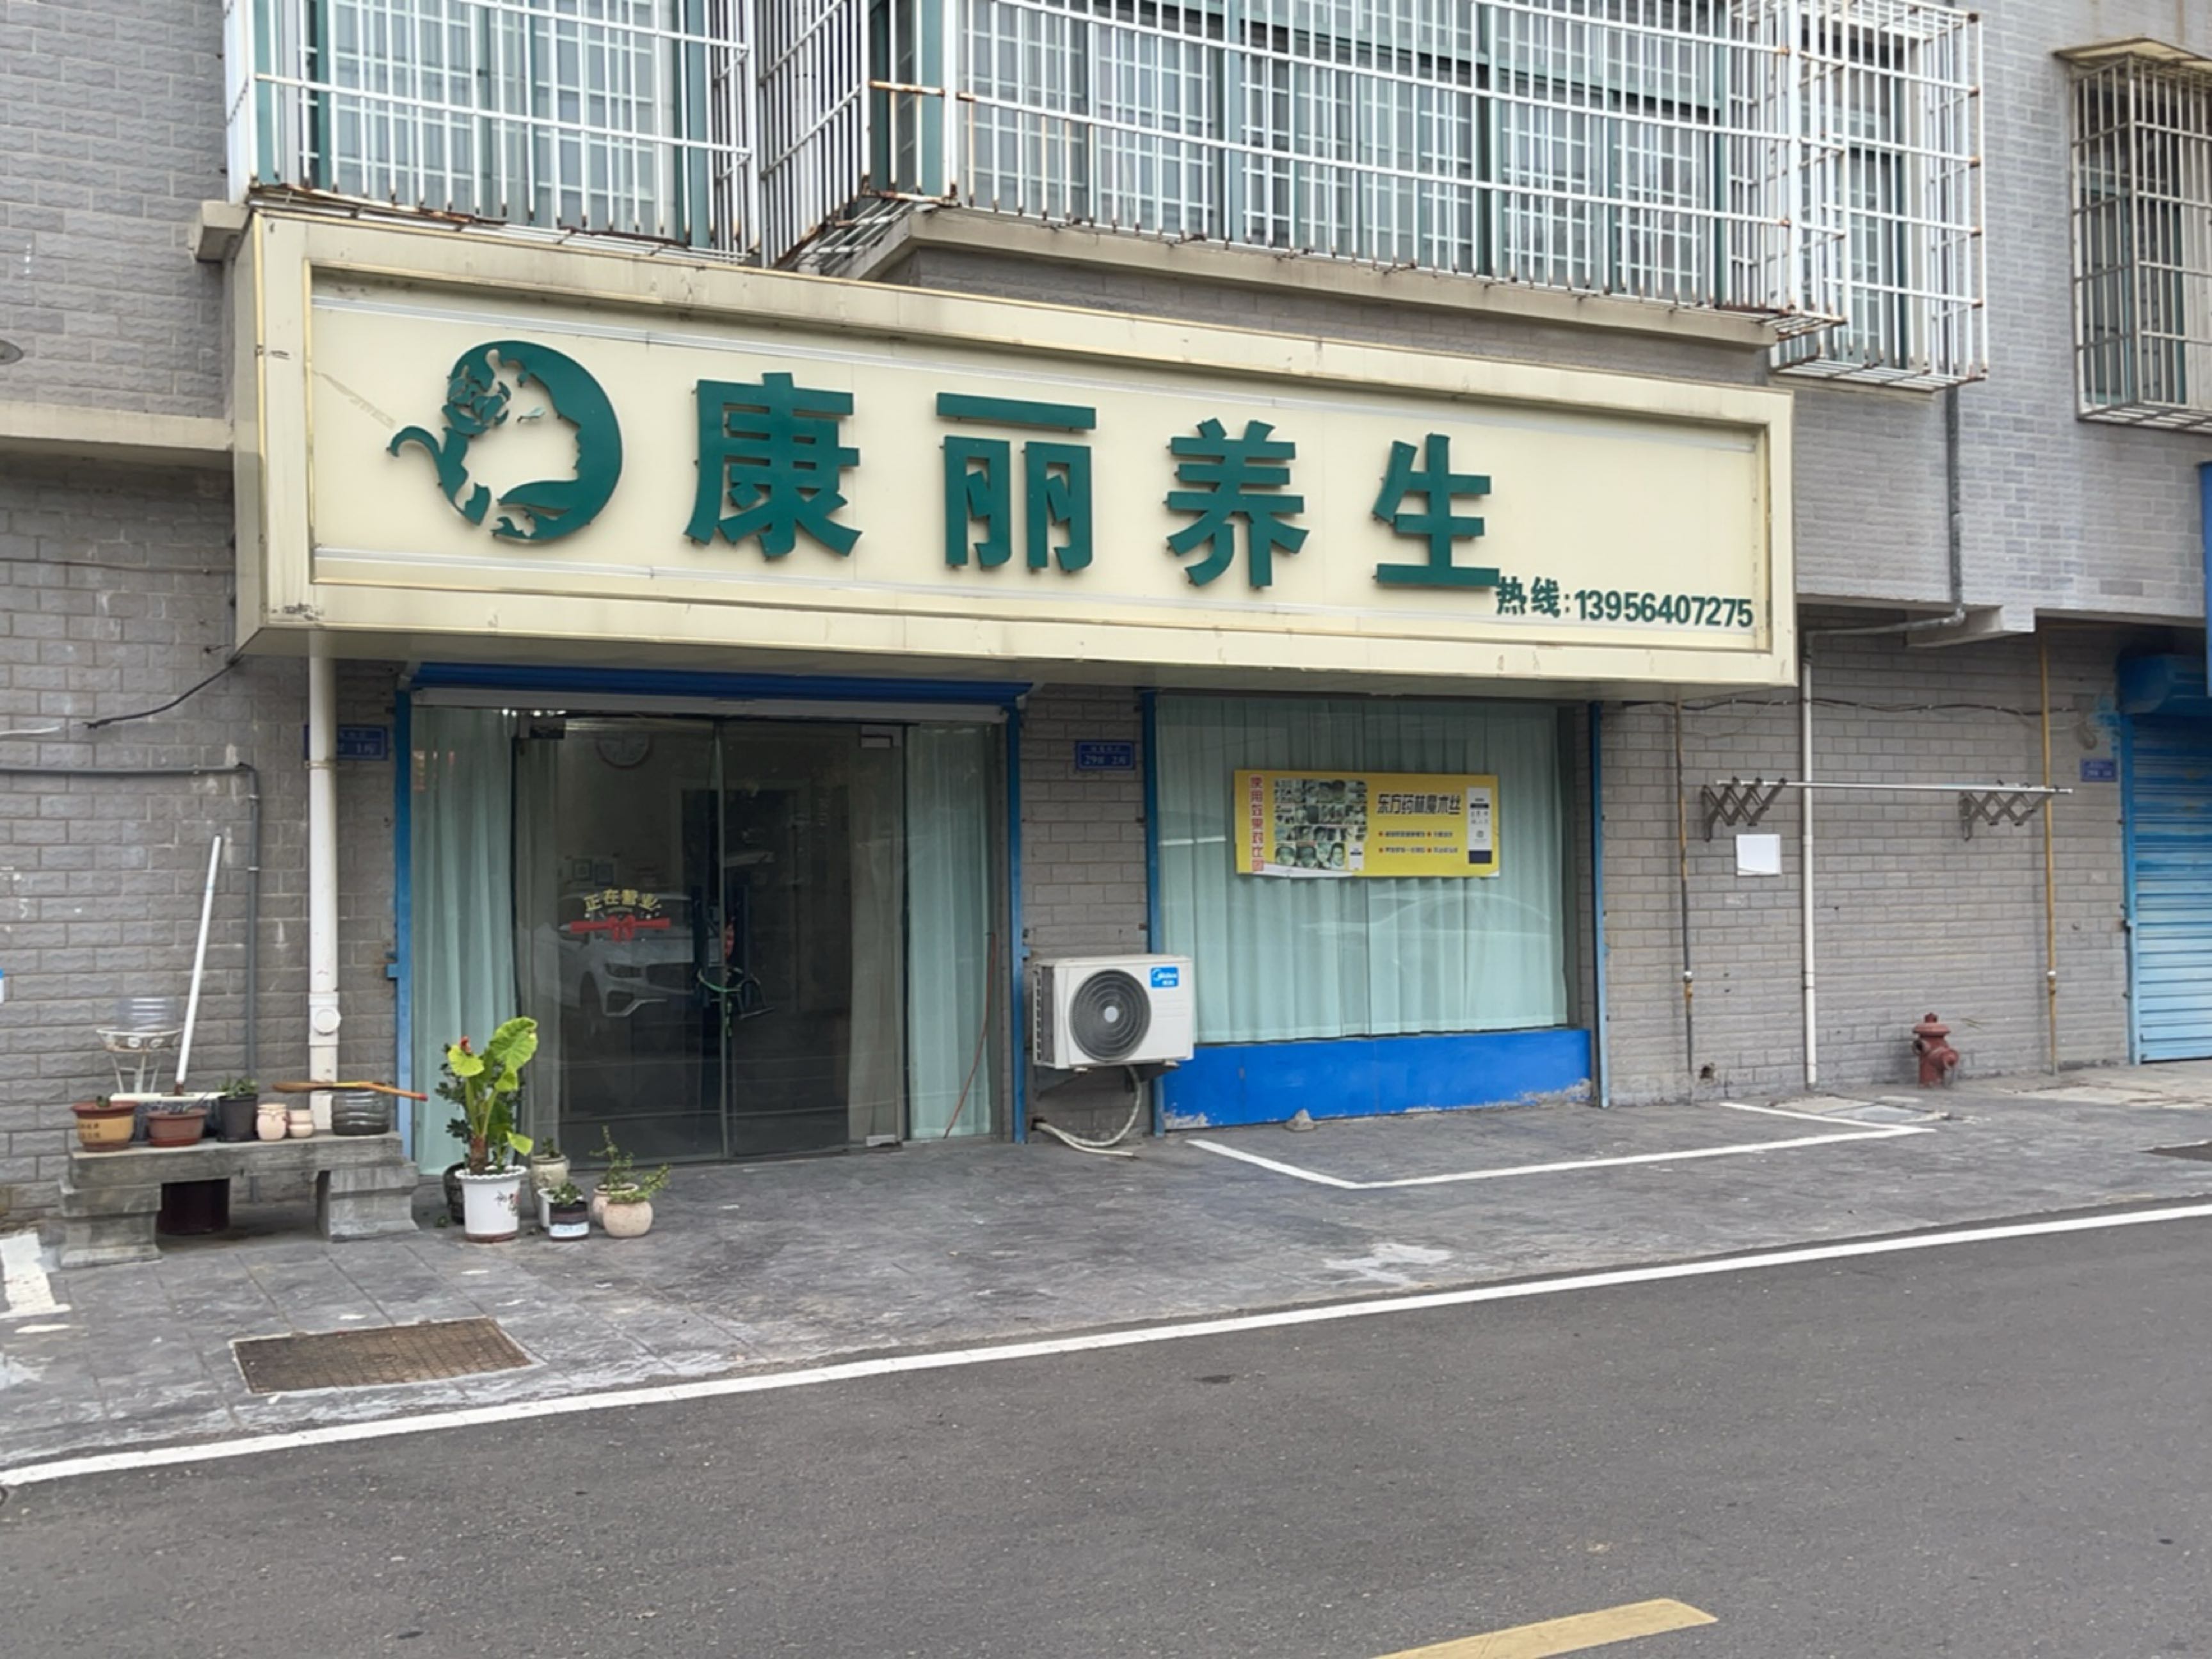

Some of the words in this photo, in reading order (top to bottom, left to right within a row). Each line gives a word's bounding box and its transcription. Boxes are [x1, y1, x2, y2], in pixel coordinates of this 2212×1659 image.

[685, 372, 1500, 590] 康丽养生
[1496, 576, 1753, 628] 热线:13956407275
